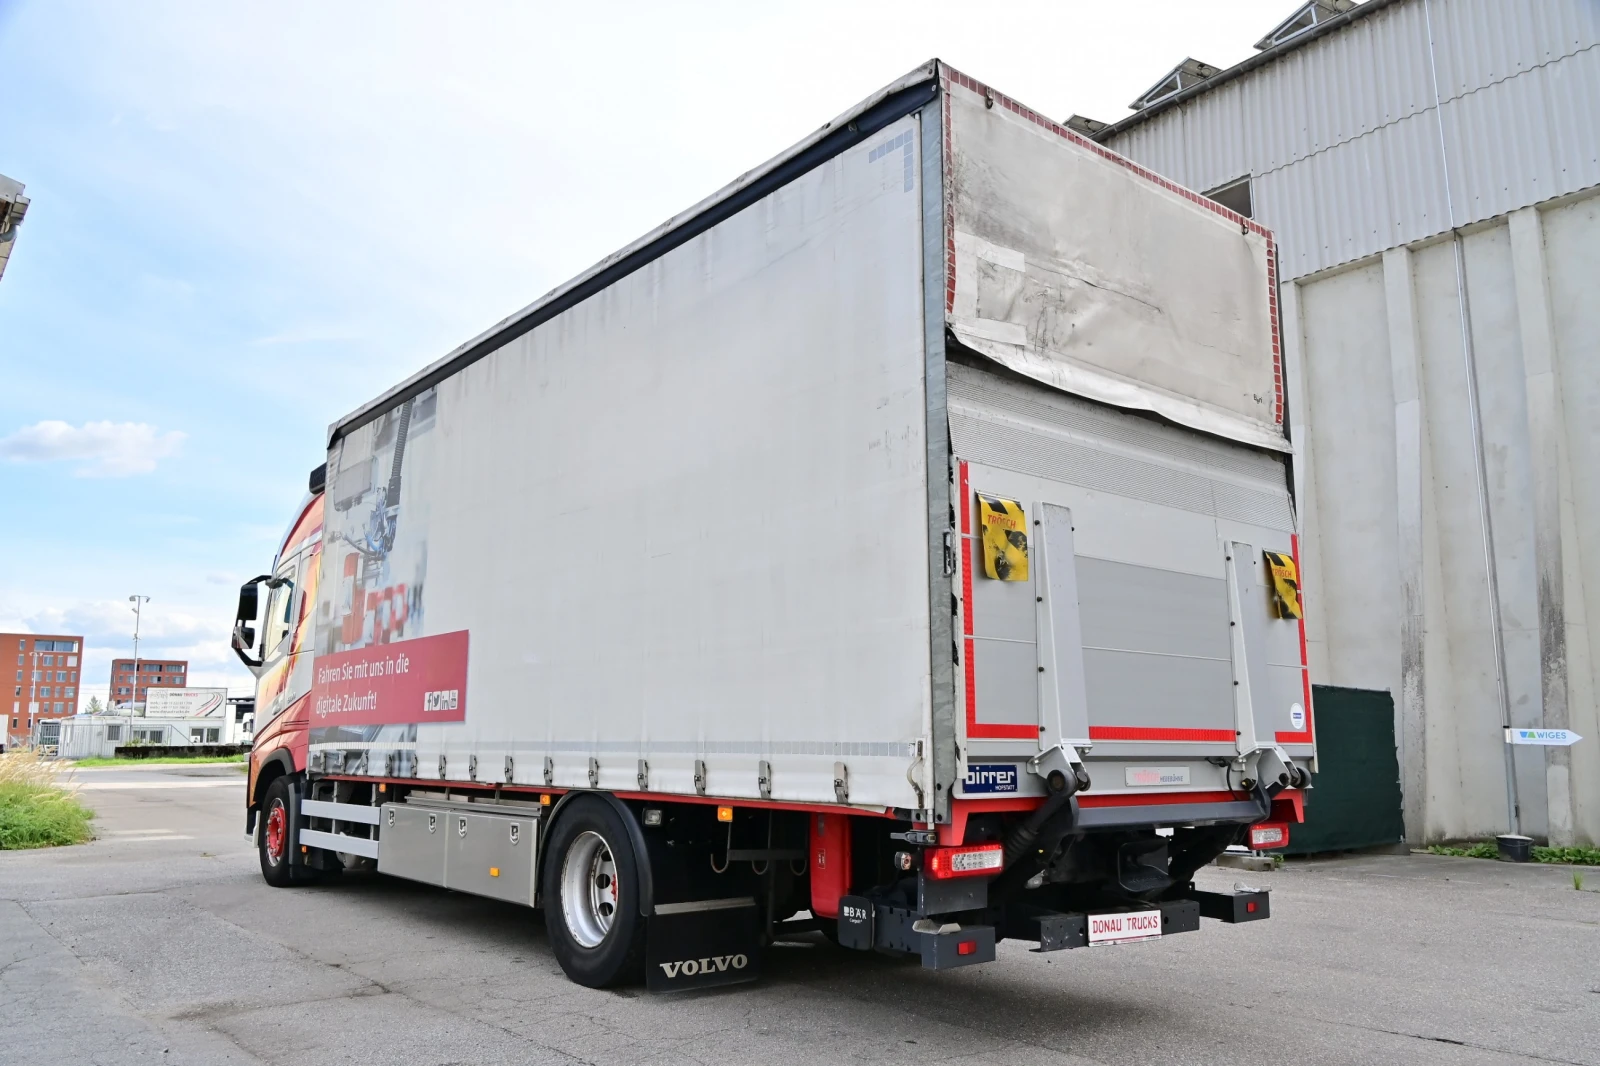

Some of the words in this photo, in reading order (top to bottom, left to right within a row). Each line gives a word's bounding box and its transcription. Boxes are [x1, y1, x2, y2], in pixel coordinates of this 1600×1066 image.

[317, 665, 341, 684] Fahren
[341, 661, 353, 681] Sie
[354, 658, 368, 679] mit
[369, 660, 384, 677] uns
[385, 655, 394, 675] in
[395, 652, 410, 674] die
[316, 693, 342, 719] digitale
[342, 689, 377, 712] Zukunft!
[1536, 731, 1567, 740] WIGES
[965, 766, 1015, 785] birrer
[849, 906, 867, 920] BÄR
[1092, 918, 1122, 934] DONAU
[1126, 915, 1158, 931] TRUCKS
[659, 953, 748, 979] VOLVO
